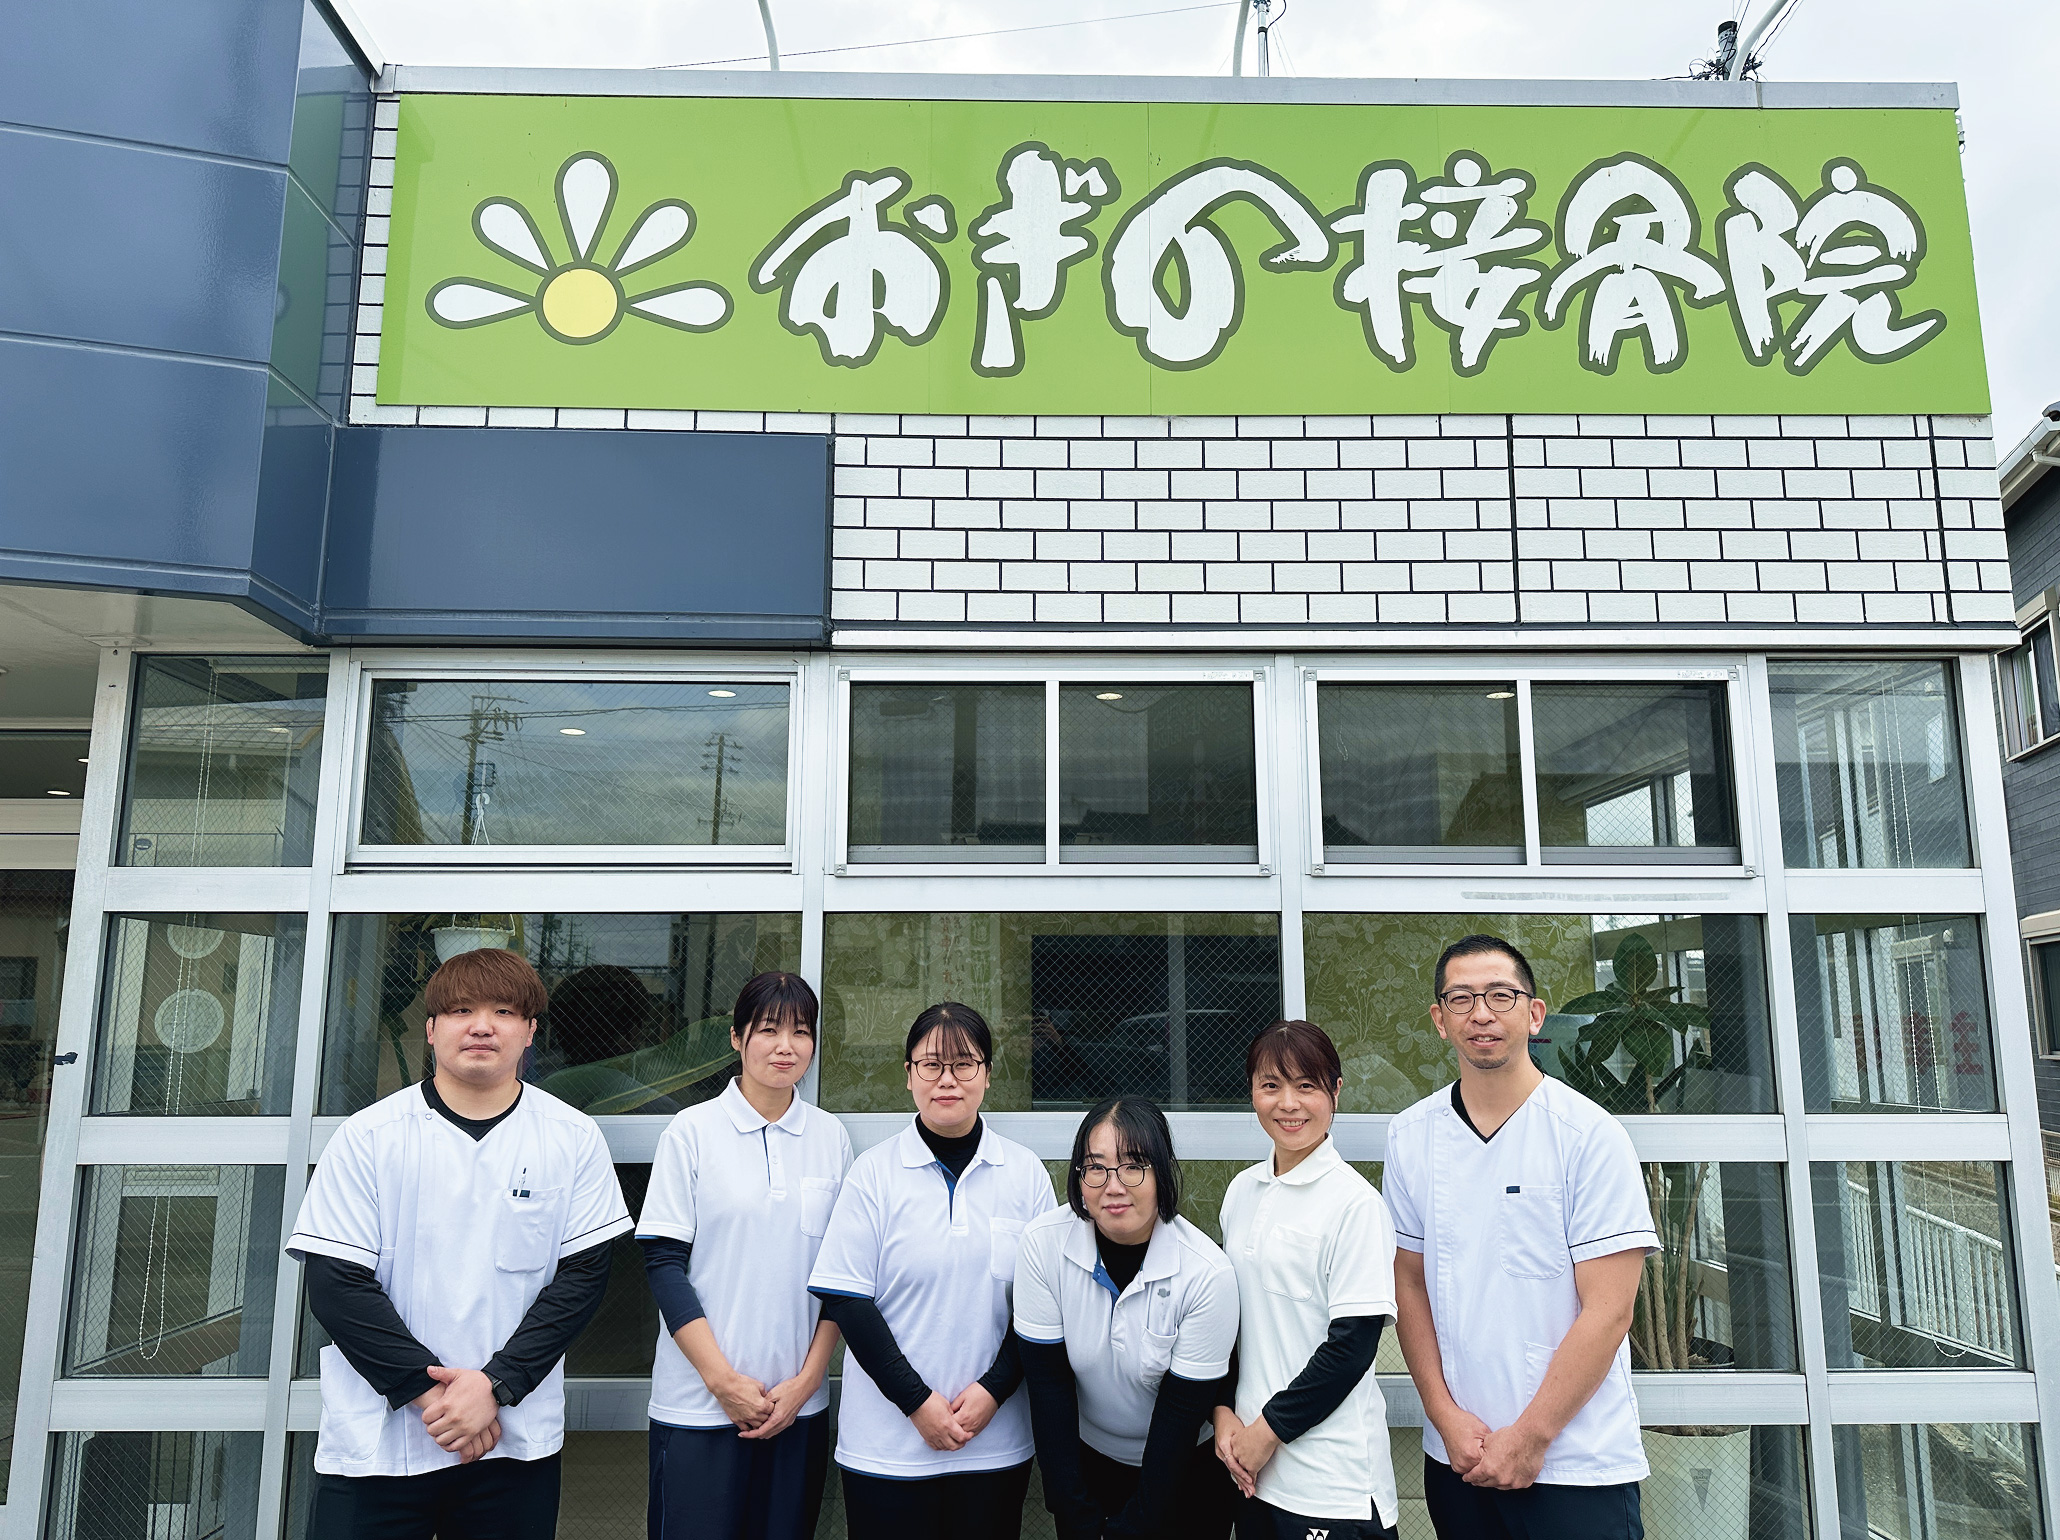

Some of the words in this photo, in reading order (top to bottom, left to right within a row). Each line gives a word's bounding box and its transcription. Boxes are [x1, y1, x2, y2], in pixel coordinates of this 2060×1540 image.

[752, 143, 1944, 376] おぎの接骨院
